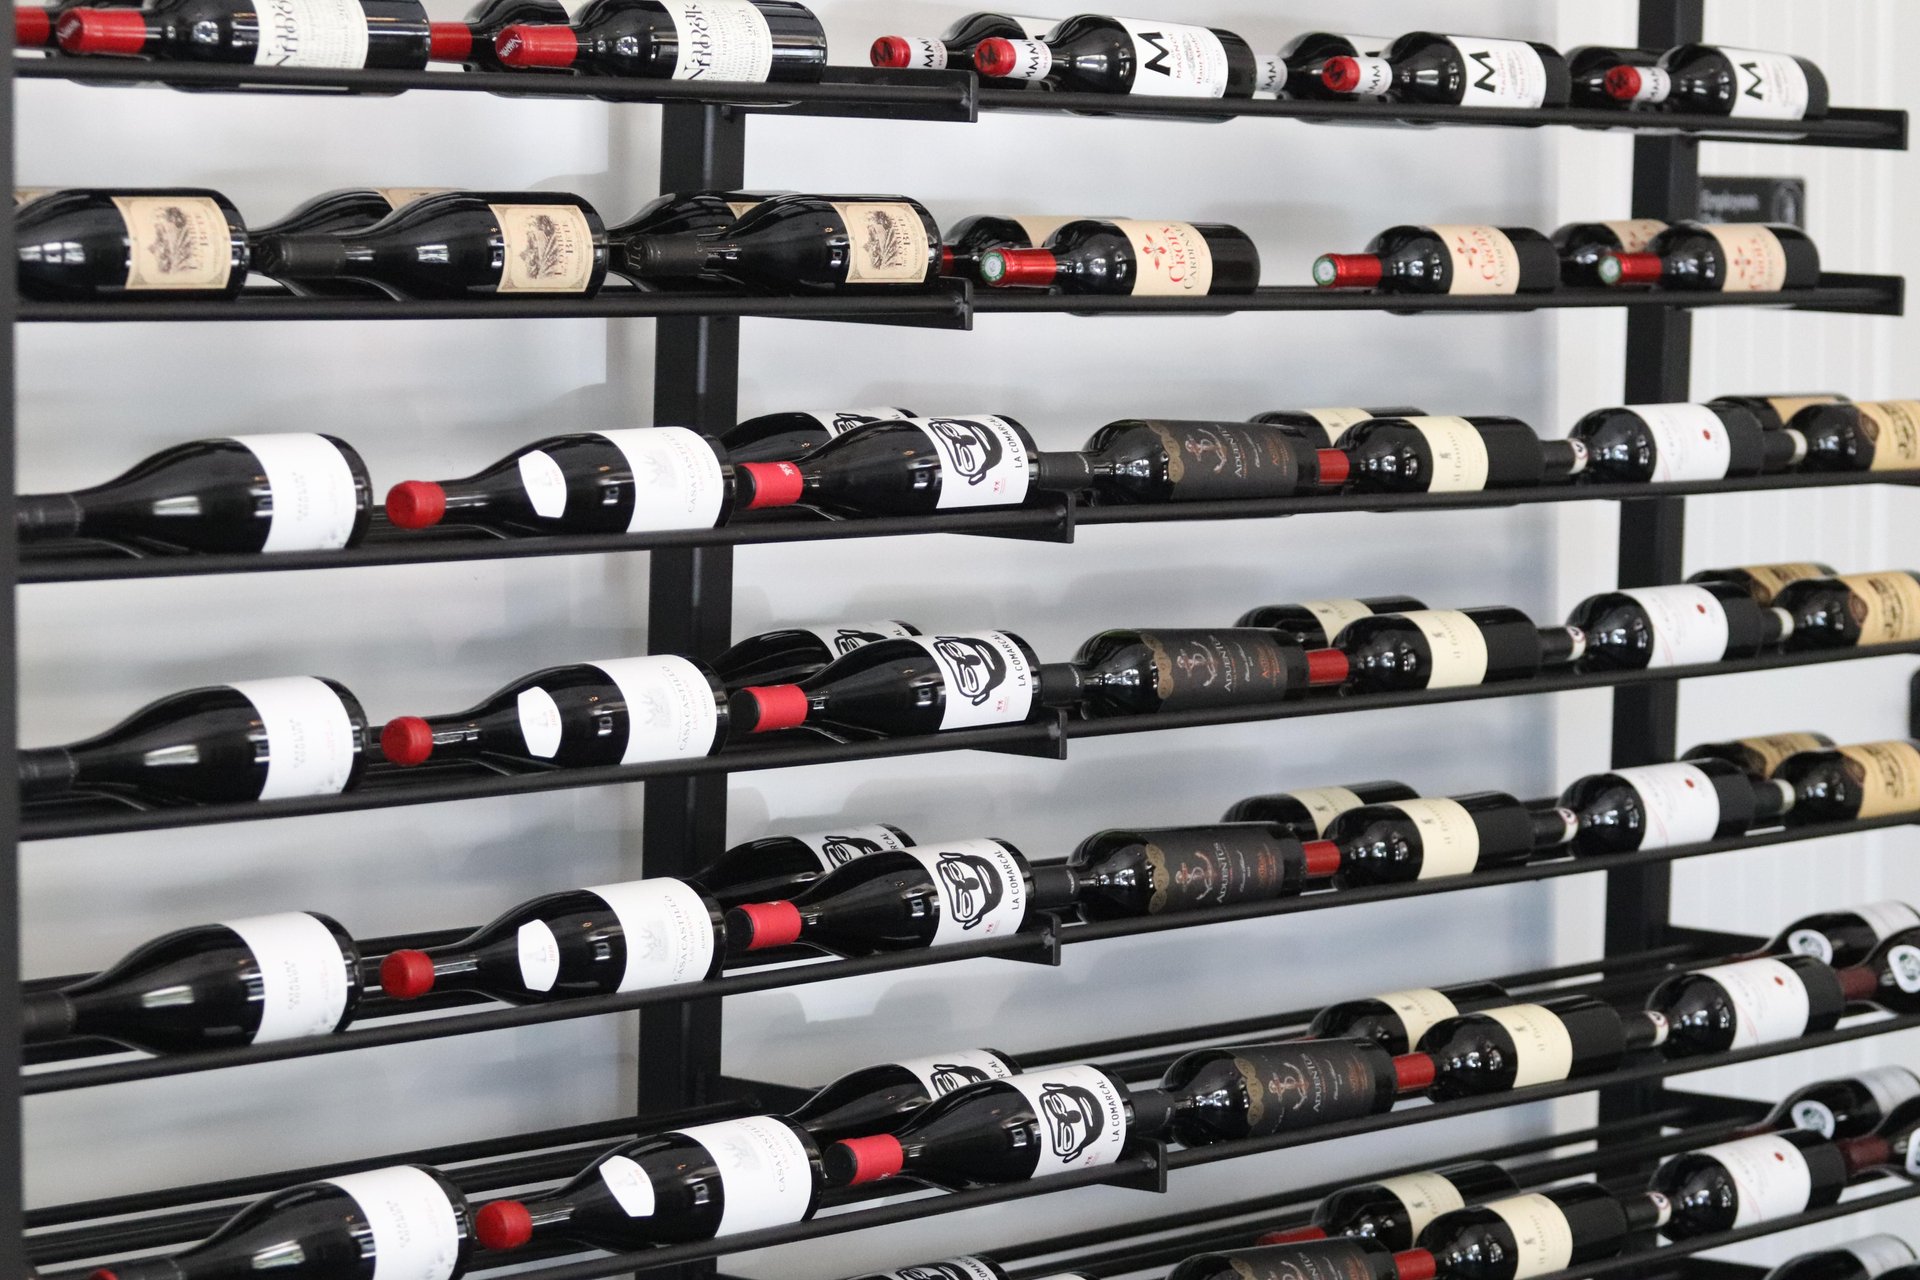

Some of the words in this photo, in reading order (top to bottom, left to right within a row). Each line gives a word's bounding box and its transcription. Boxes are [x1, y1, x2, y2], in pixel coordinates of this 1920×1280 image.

[1137, 32, 1171, 76] M
[1468, 51, 1496, 93] M
[1738, 61, 1764, 101] M
[1162, 227, 1186, 283] CROIX
[1013, 455, 1023, 469] LA
[991, 631, 1024, 671] COMARCAL
[1017, 672, 1026, 687] LA
[994, 849, 1019, 895] COMARCAL
[664, 894, 688, 953] CASTILLO
[1011, 896, 1021, 911] LA
[1096, 1079, 1120, 1127] COMARCAL
[1111, 1128, 1121, 1143] LA
